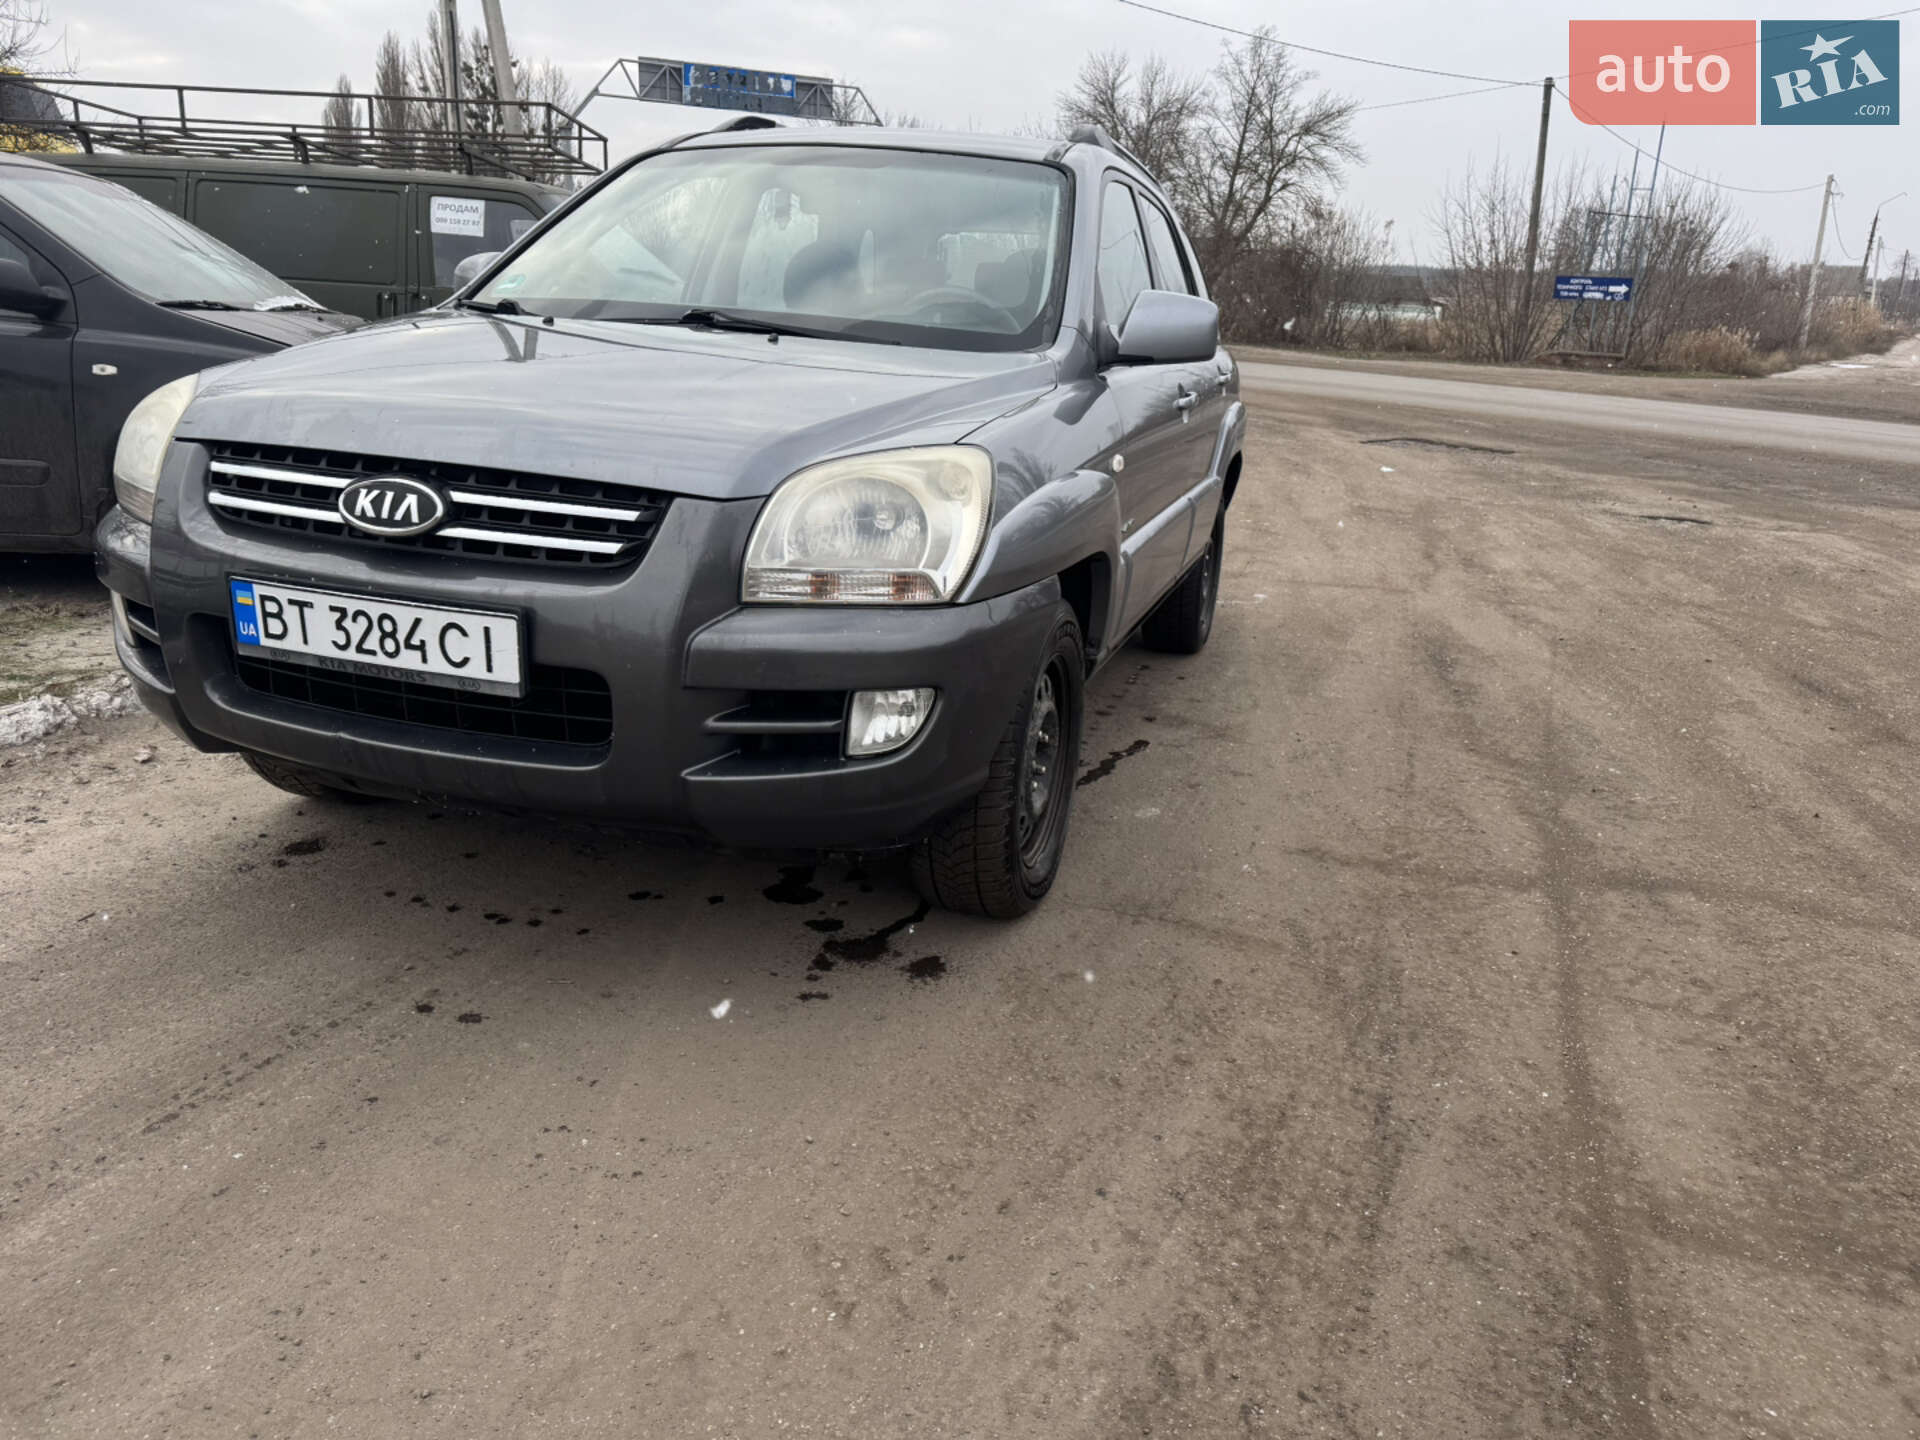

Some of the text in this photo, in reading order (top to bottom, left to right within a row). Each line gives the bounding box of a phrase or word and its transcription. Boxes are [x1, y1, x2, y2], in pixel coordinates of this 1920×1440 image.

[437, 203, 479, 214] ПРОДАМ
[354, 488, 420, 524] KIA
[239, 621, 257, 637] UA
[259, 594, 493, 673] BT 3284 CI
[353, 662, 428, 683] MOTORS
